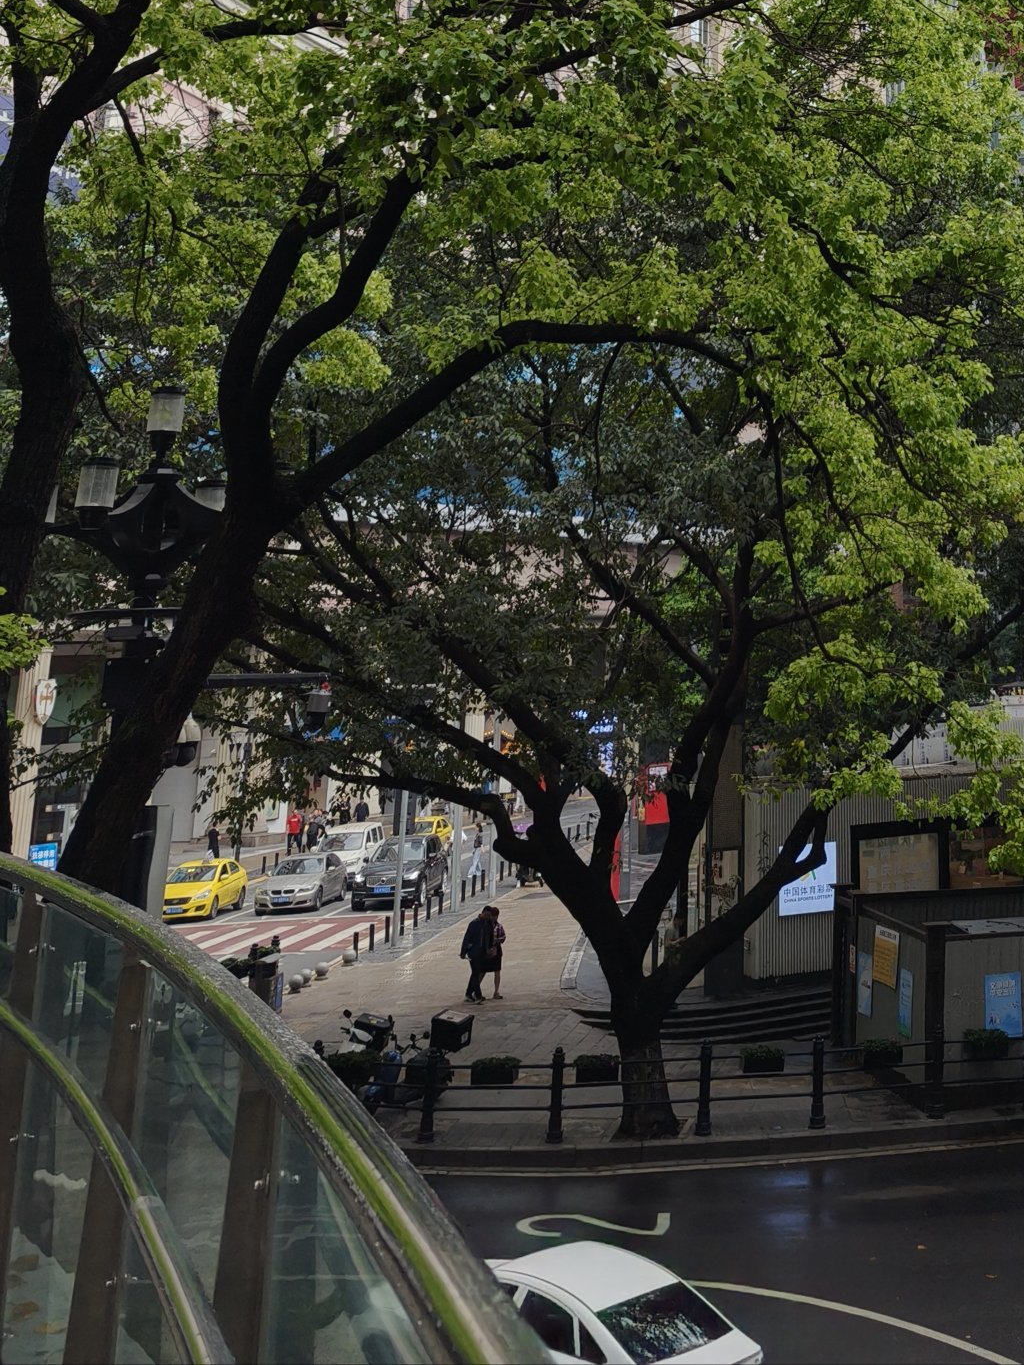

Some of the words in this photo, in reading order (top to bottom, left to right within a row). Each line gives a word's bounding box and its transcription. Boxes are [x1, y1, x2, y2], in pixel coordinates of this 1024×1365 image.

[783, 884, 833, 897] 中国体育彩票
